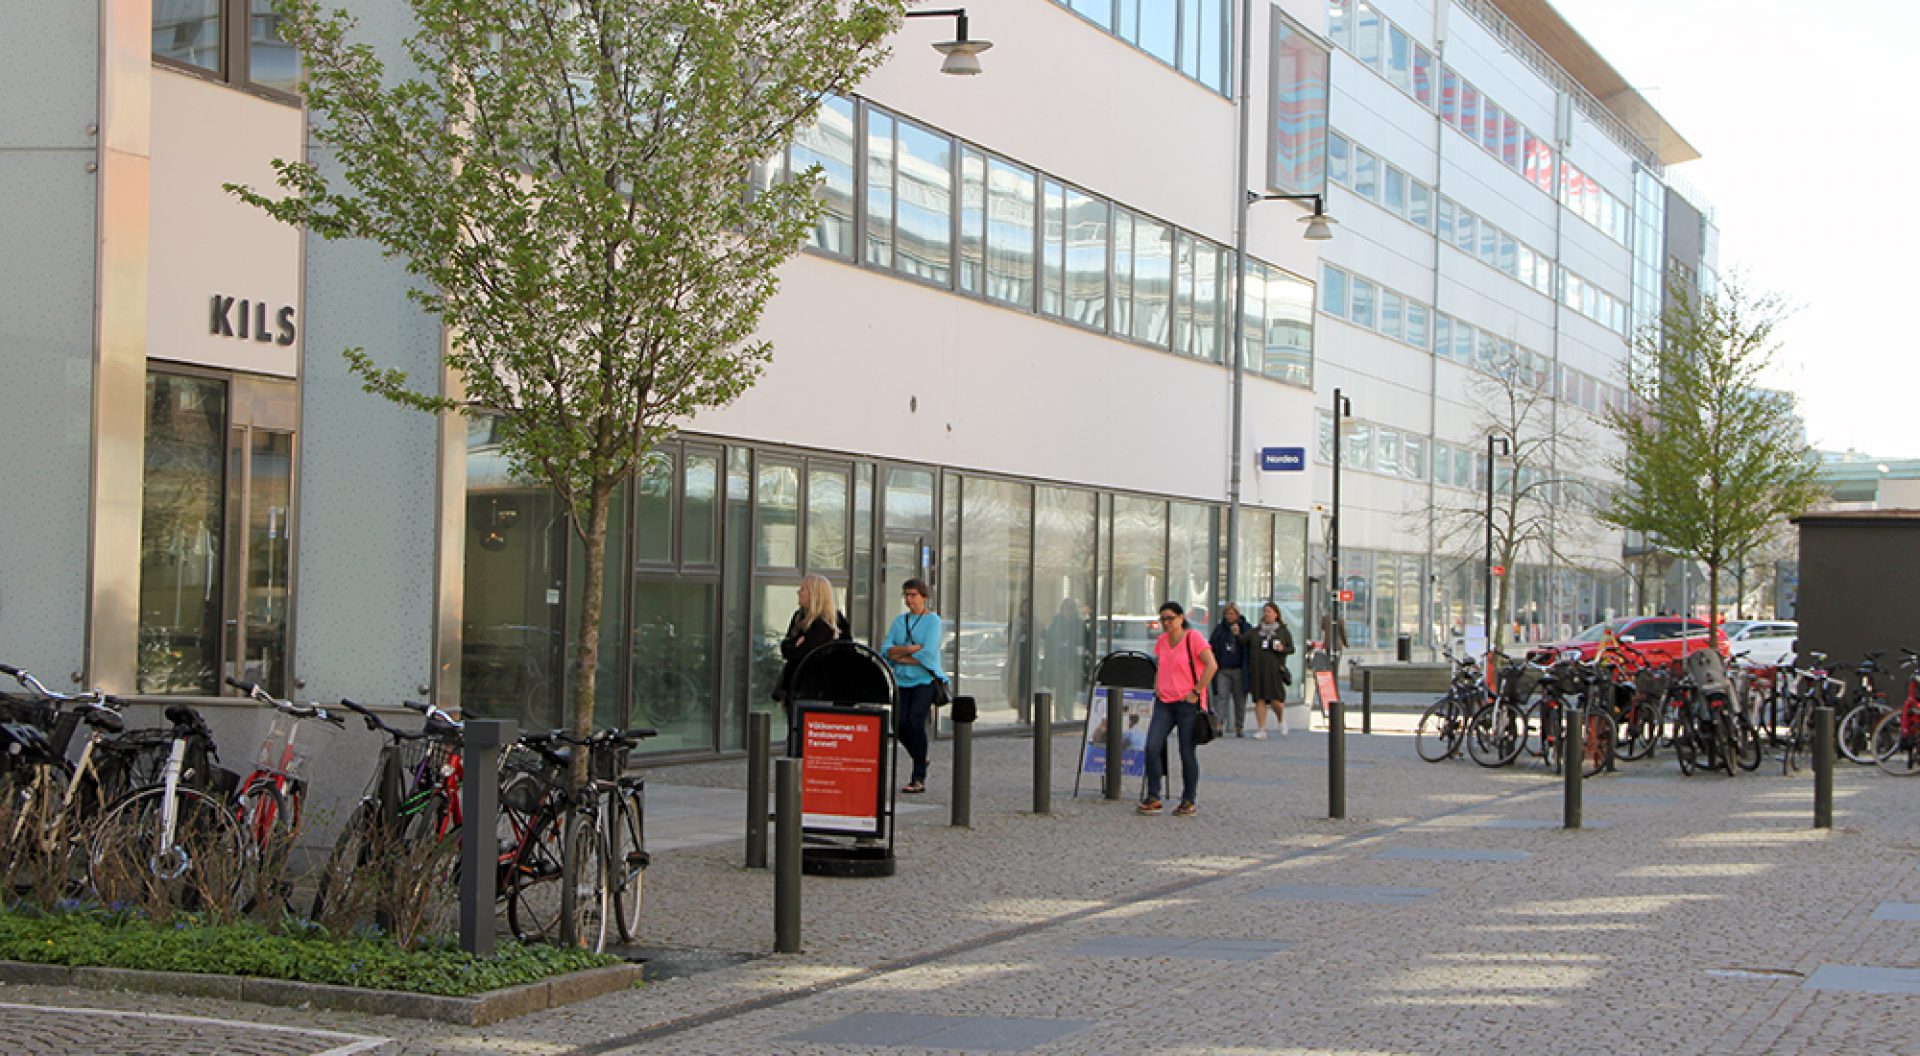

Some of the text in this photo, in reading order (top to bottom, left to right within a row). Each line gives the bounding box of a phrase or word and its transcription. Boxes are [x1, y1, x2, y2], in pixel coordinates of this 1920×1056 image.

[209, 294, 296, 347] KILS
[1266, 454, 1299, 464] Nordea
[808, 721, 855, 731] Välkommen
[808, 730, 853, 742] Restaurang
